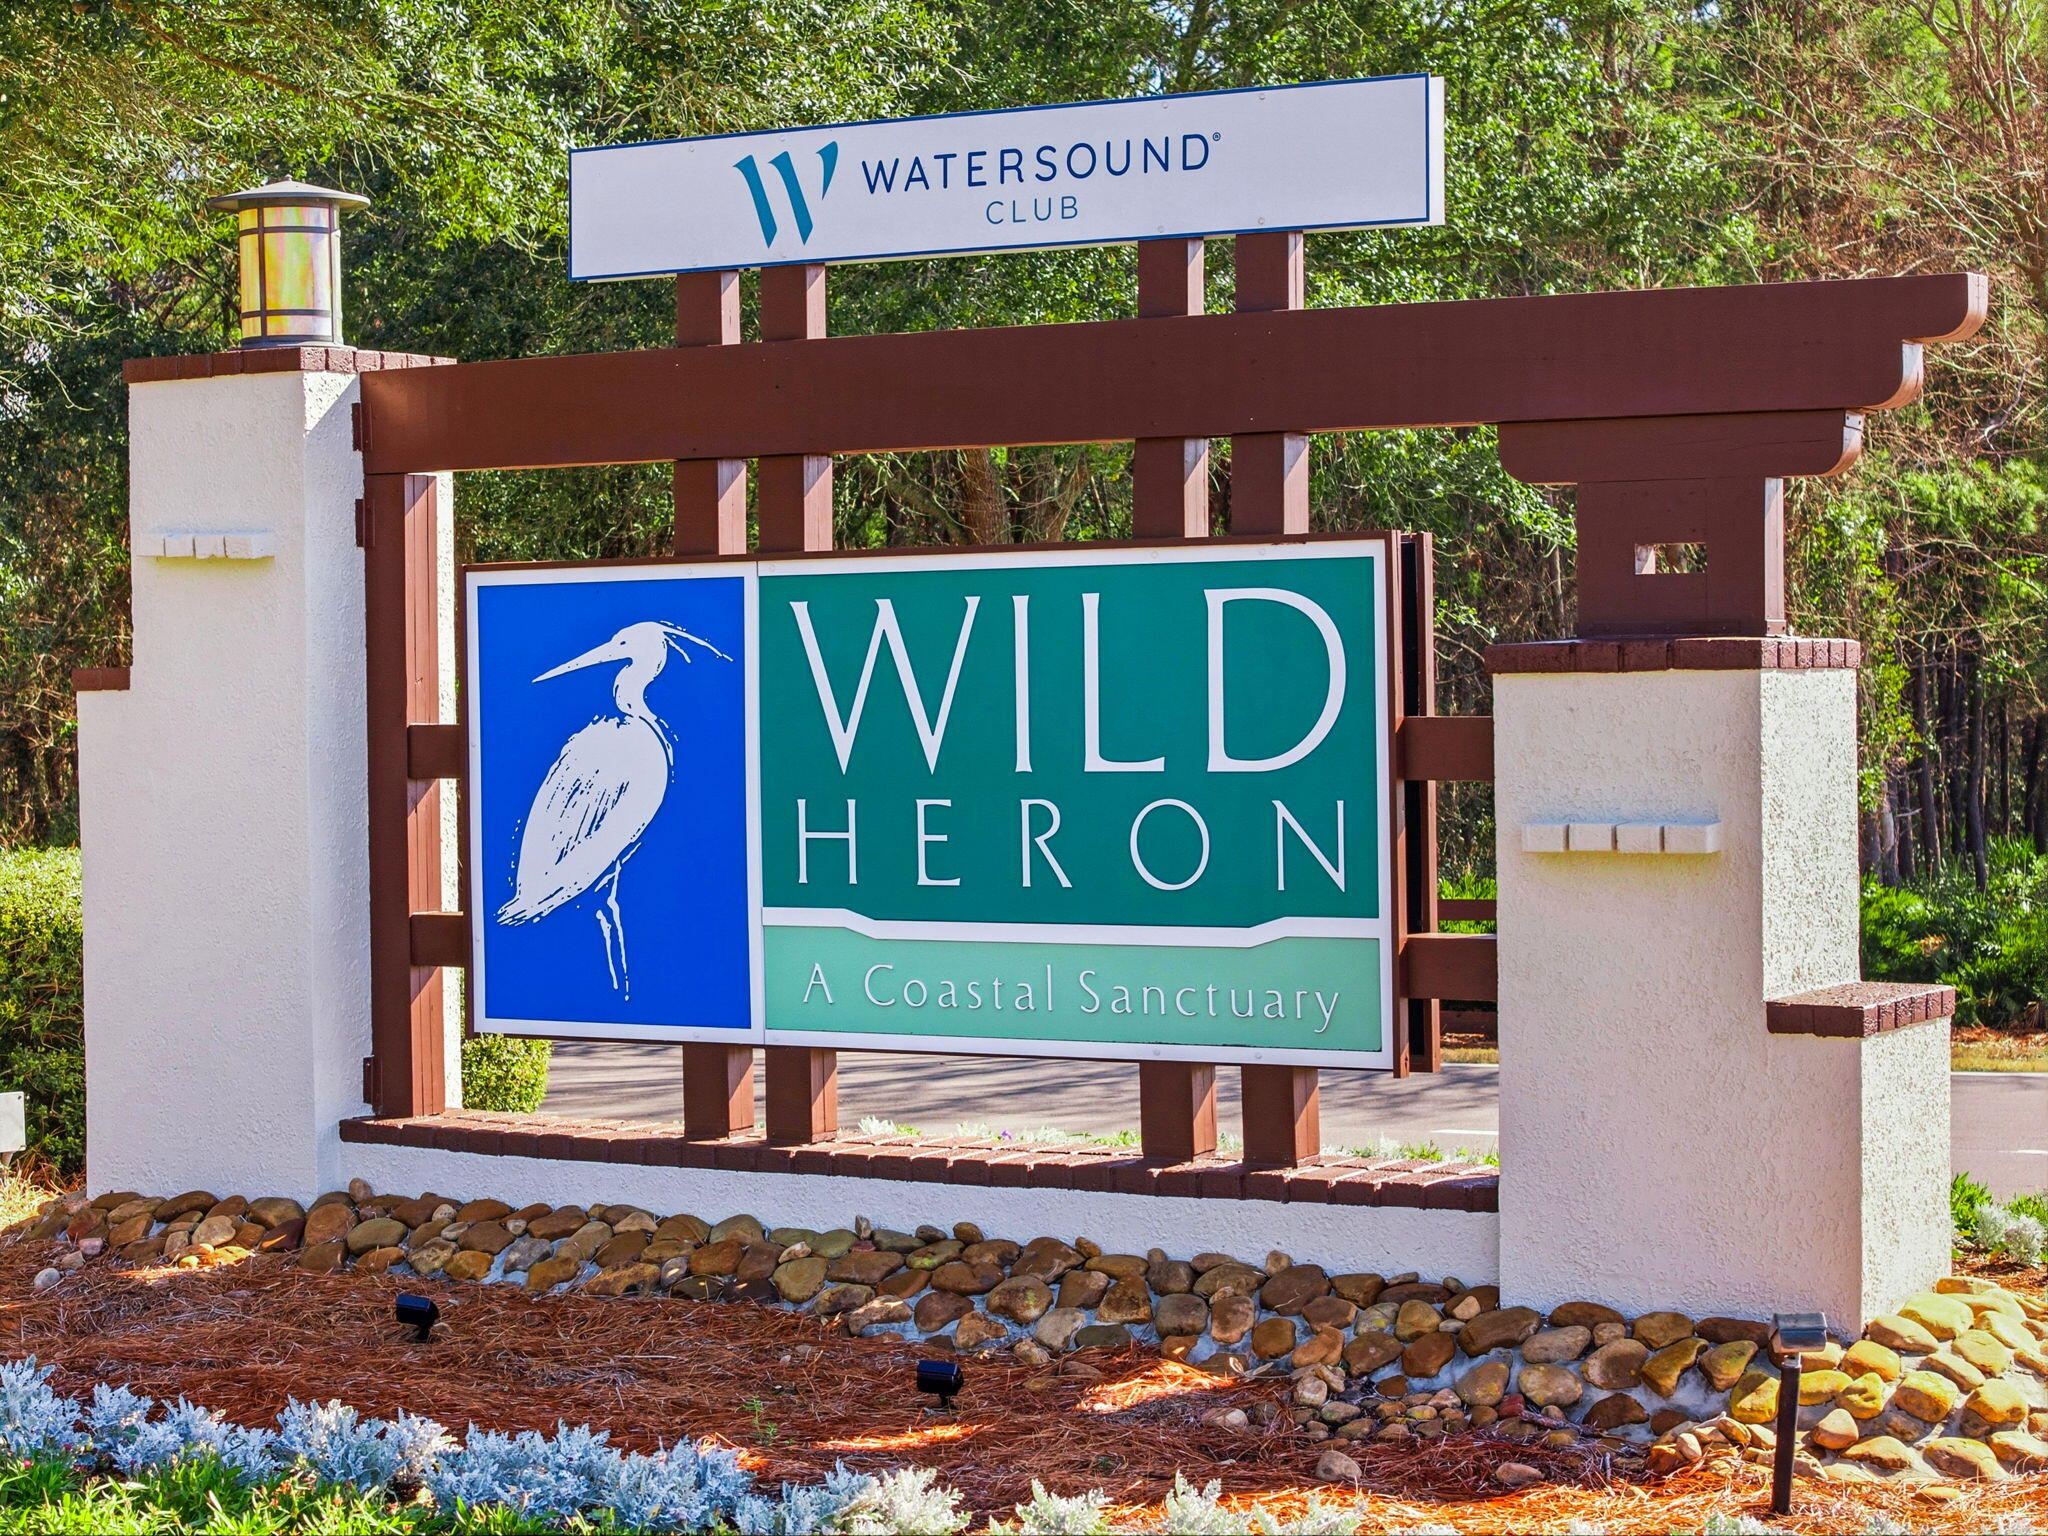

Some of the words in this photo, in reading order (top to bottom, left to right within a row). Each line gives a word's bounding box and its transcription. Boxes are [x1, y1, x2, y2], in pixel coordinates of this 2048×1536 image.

[986, 196, 1079, 225] CLUB
[790, 587, 1347, 775] WILD
[796, 798, 1347, 893] HERON
[803, 963, 834, 1004] A
[864, 964, 1054, 1011] Coastal
[1079, 970, 1340, 1033] Sanctuary
